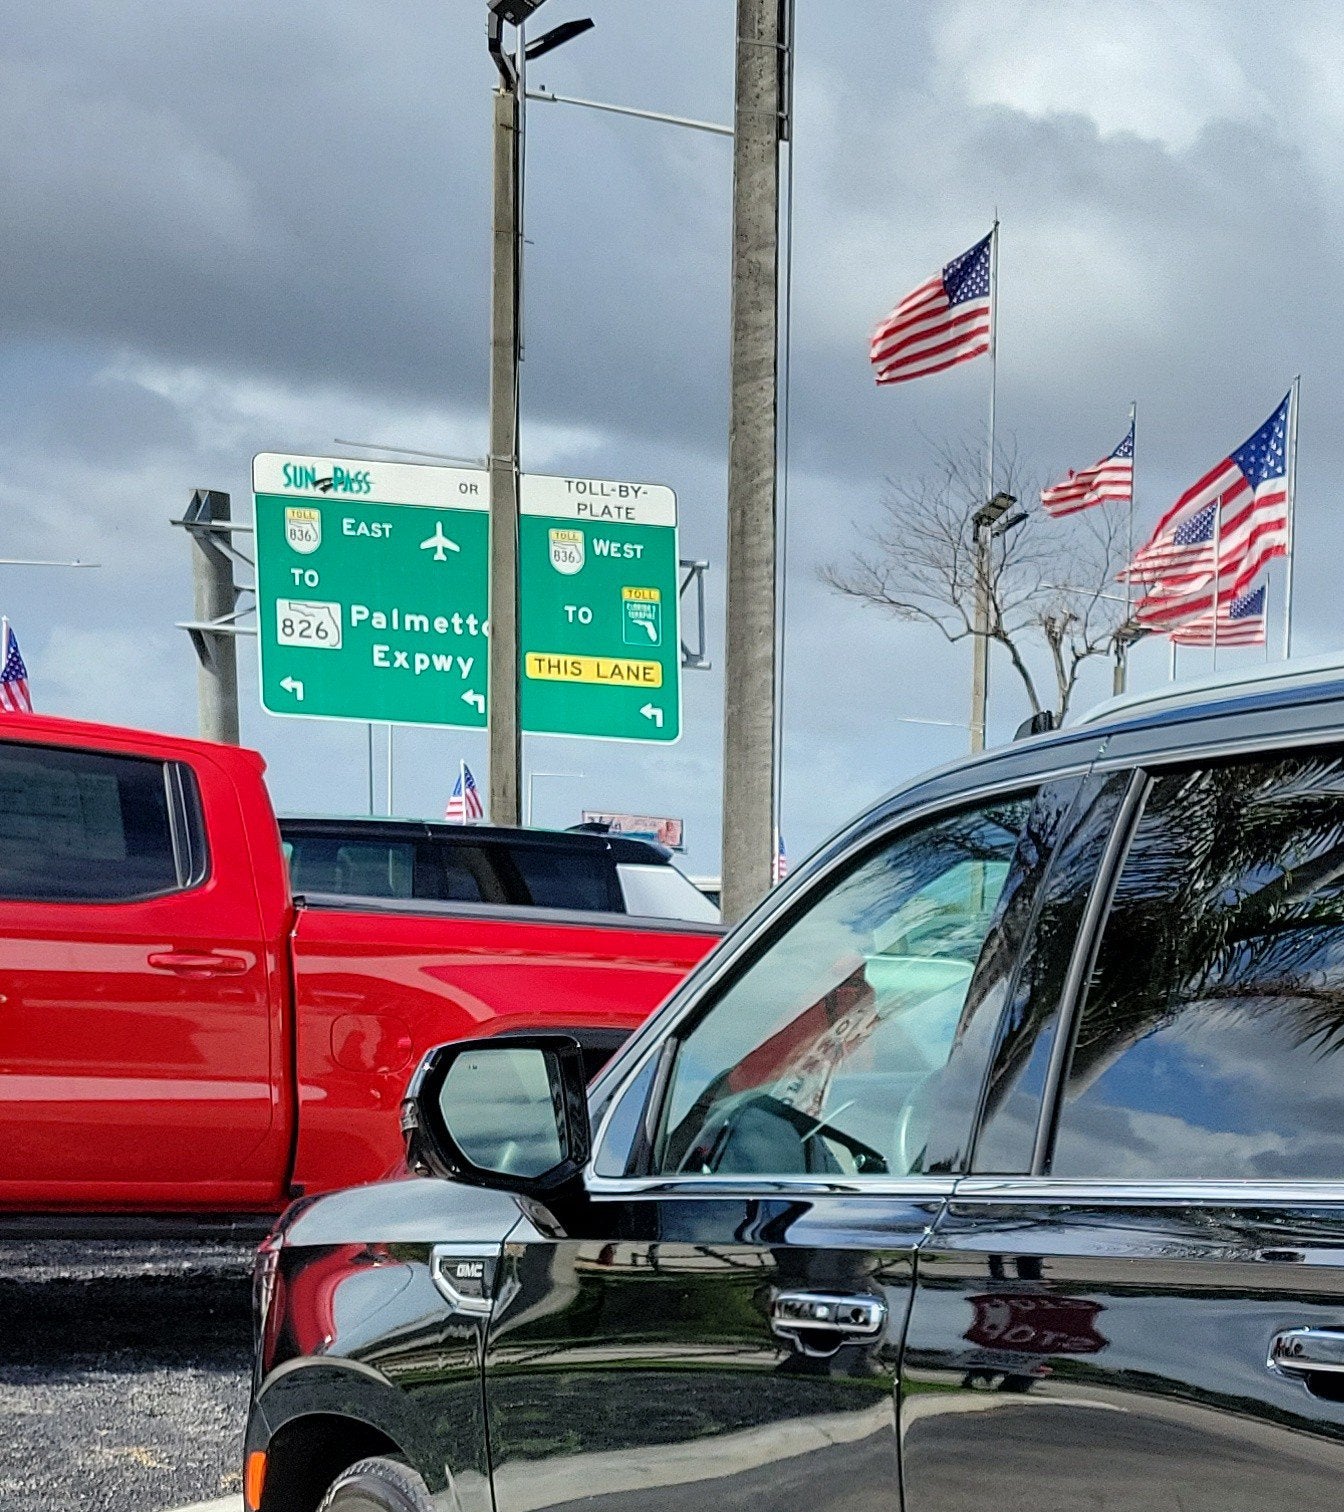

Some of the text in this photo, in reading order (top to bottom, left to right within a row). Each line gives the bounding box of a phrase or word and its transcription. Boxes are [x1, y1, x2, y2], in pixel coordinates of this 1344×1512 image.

[459, 483, 479, 495] OR
[291, 510, 315, 520] TOLL
[577, 503, 635, 520] PLATE
[290, 528, 312, 542] 836
[555, 532, 579, 541] TOLL
[553, 550, 575, 563] 836
[593, 538, 644, 559] WEST
[290, 568, 319, 587] TO
[627, 590, 655, 600] TOLL
[564, 605, 593, 624] TO
[282, 618, 328, 640] 826
[373, 644, 474, 680] Expwy
[534, 658, 655, 682] THIS LANE
[457, 1261, 484, 1278] GMC
